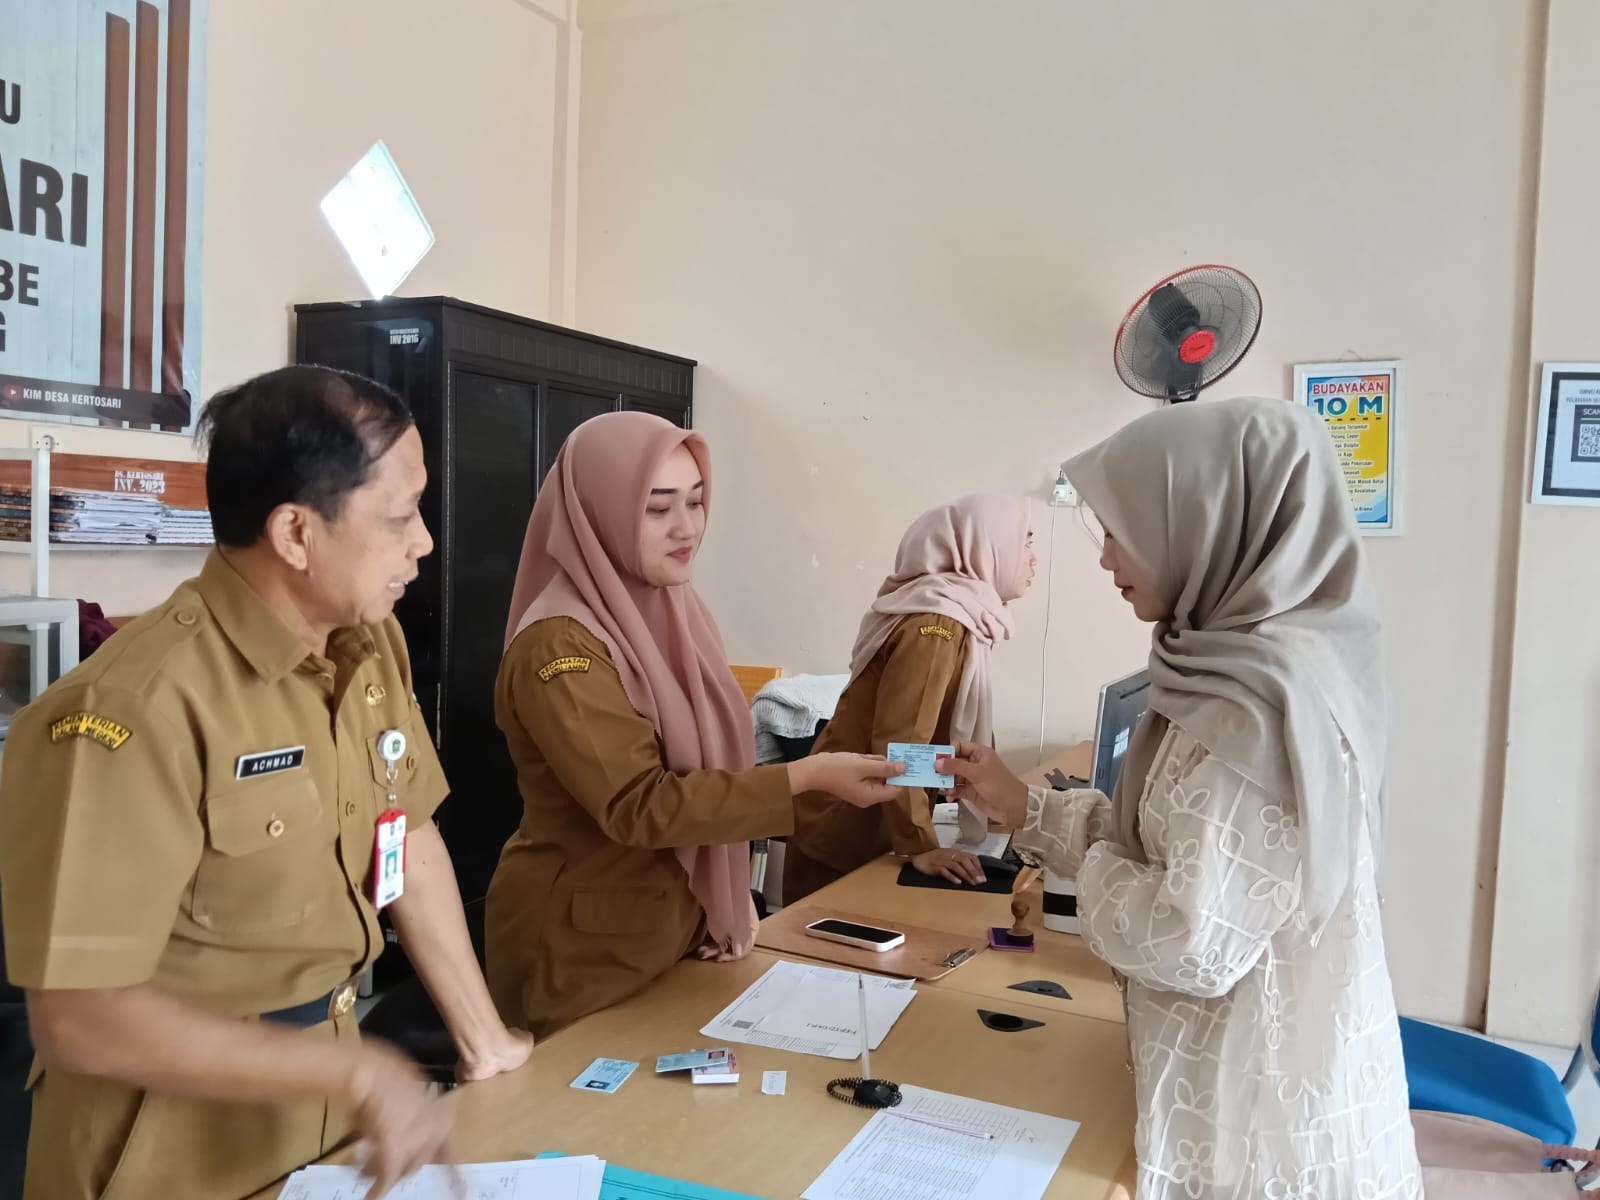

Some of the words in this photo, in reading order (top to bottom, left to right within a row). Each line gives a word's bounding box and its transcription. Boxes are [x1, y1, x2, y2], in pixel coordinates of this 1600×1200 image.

[1313, 382, 1384, 395] BUDAYAKAN
[23, 388, 42, 400] KIM
[45, 391, 69, 404] DESA
[71, 394, 122, 409] KERTOSARI
[1313, 396, 1348, 416] 10
[1358, 395, 1383, 415] M
[252, 754, 294, 771] ACHMAD
